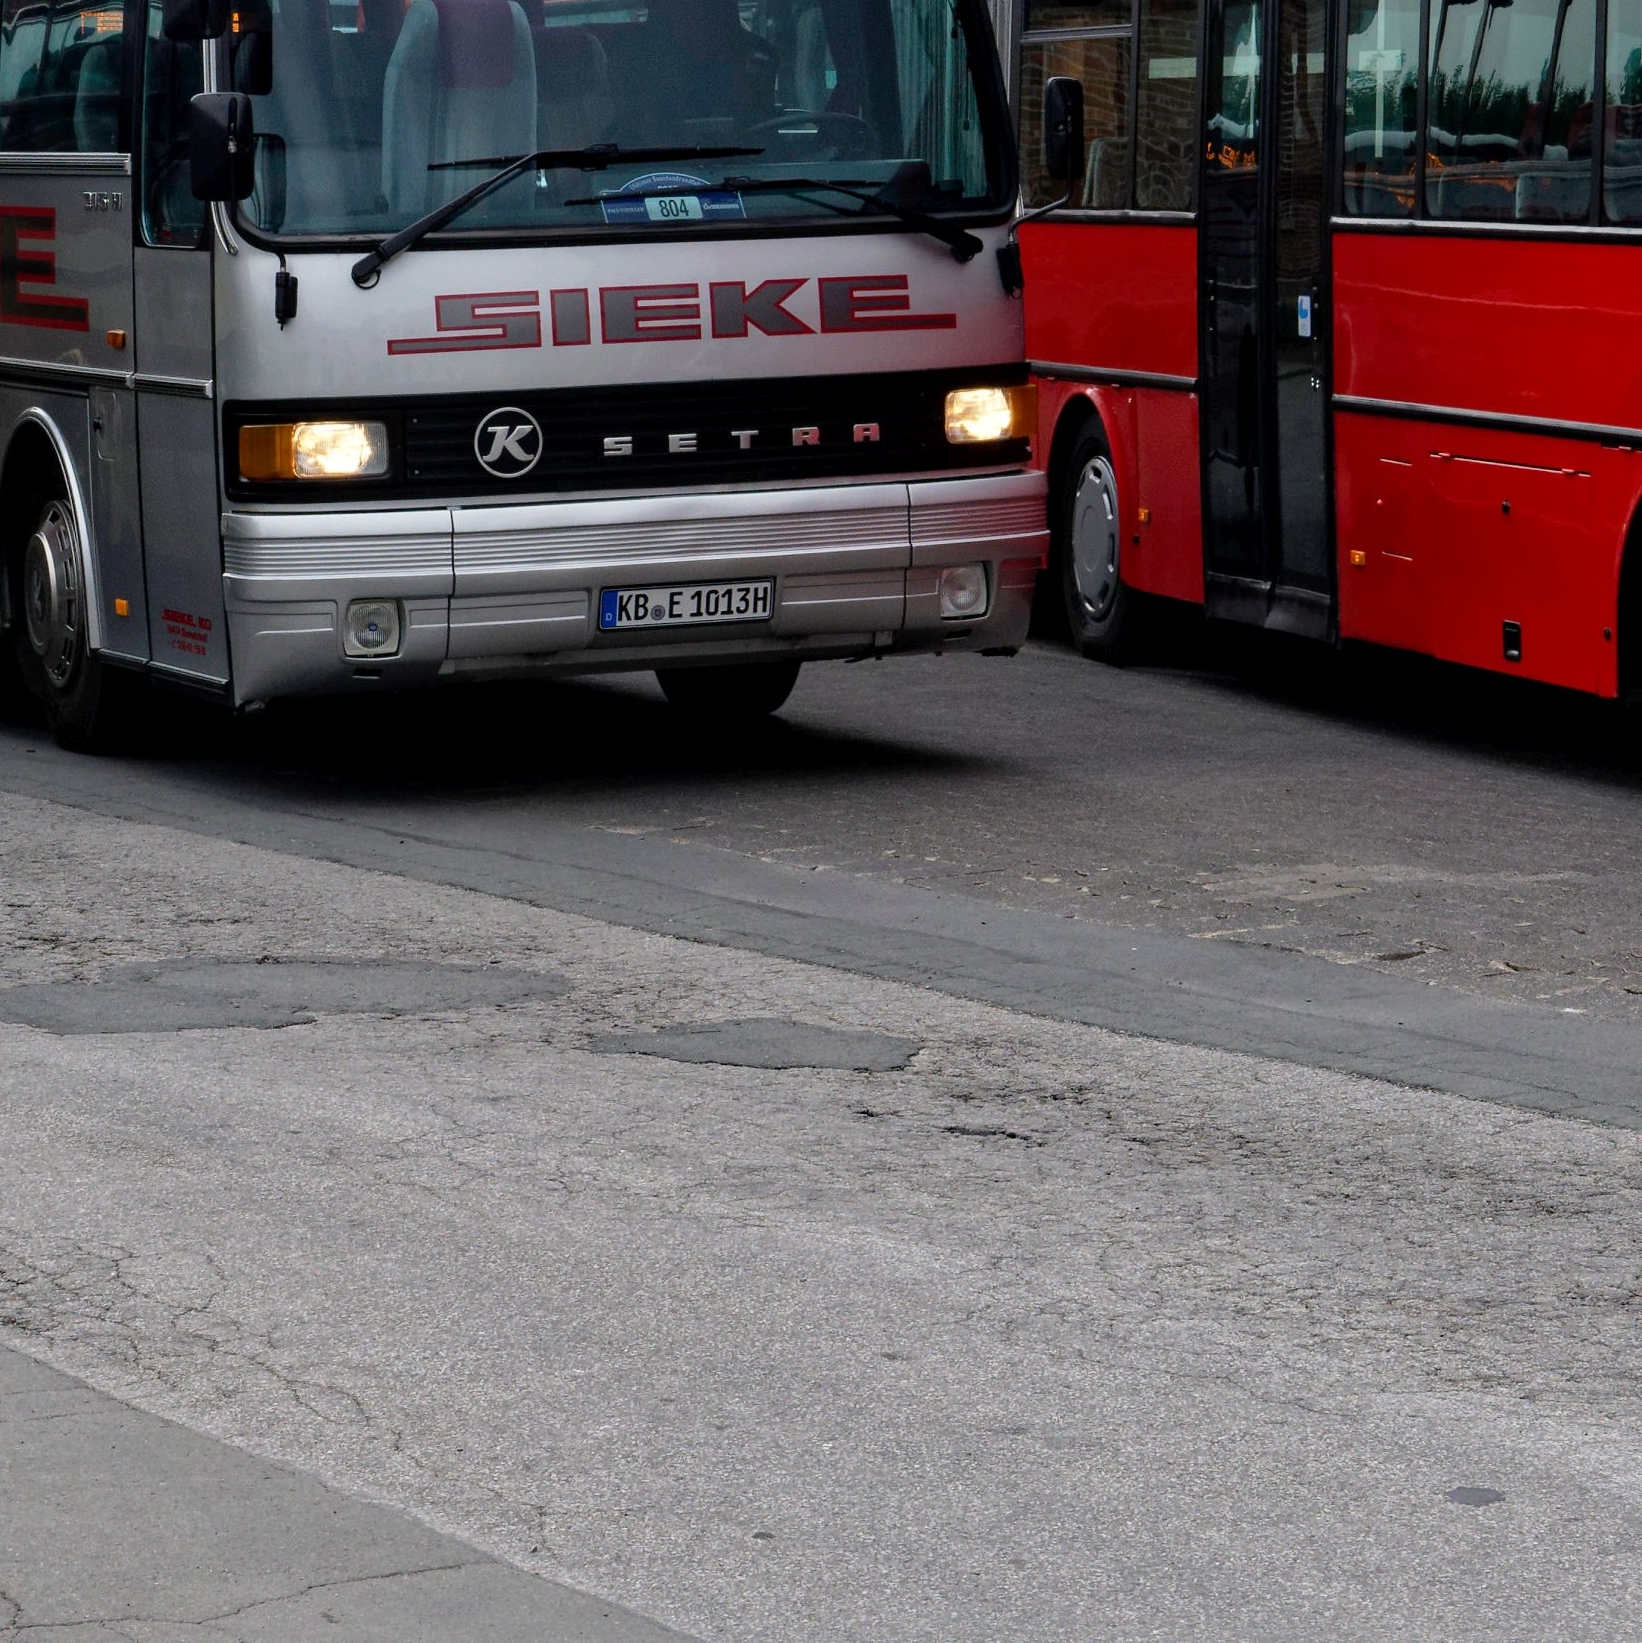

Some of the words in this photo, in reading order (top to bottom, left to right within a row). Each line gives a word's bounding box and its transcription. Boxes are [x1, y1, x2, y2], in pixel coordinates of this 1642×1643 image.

[659, 199, 689, 217] 804
[387, 274, 957, 356] SIEKE
[603, 422, 881, 458] SETRA
[617, 593, 649, 622] KB
[668, 591, 683, 619] E
[689, 586, 769, 618] 1013H
